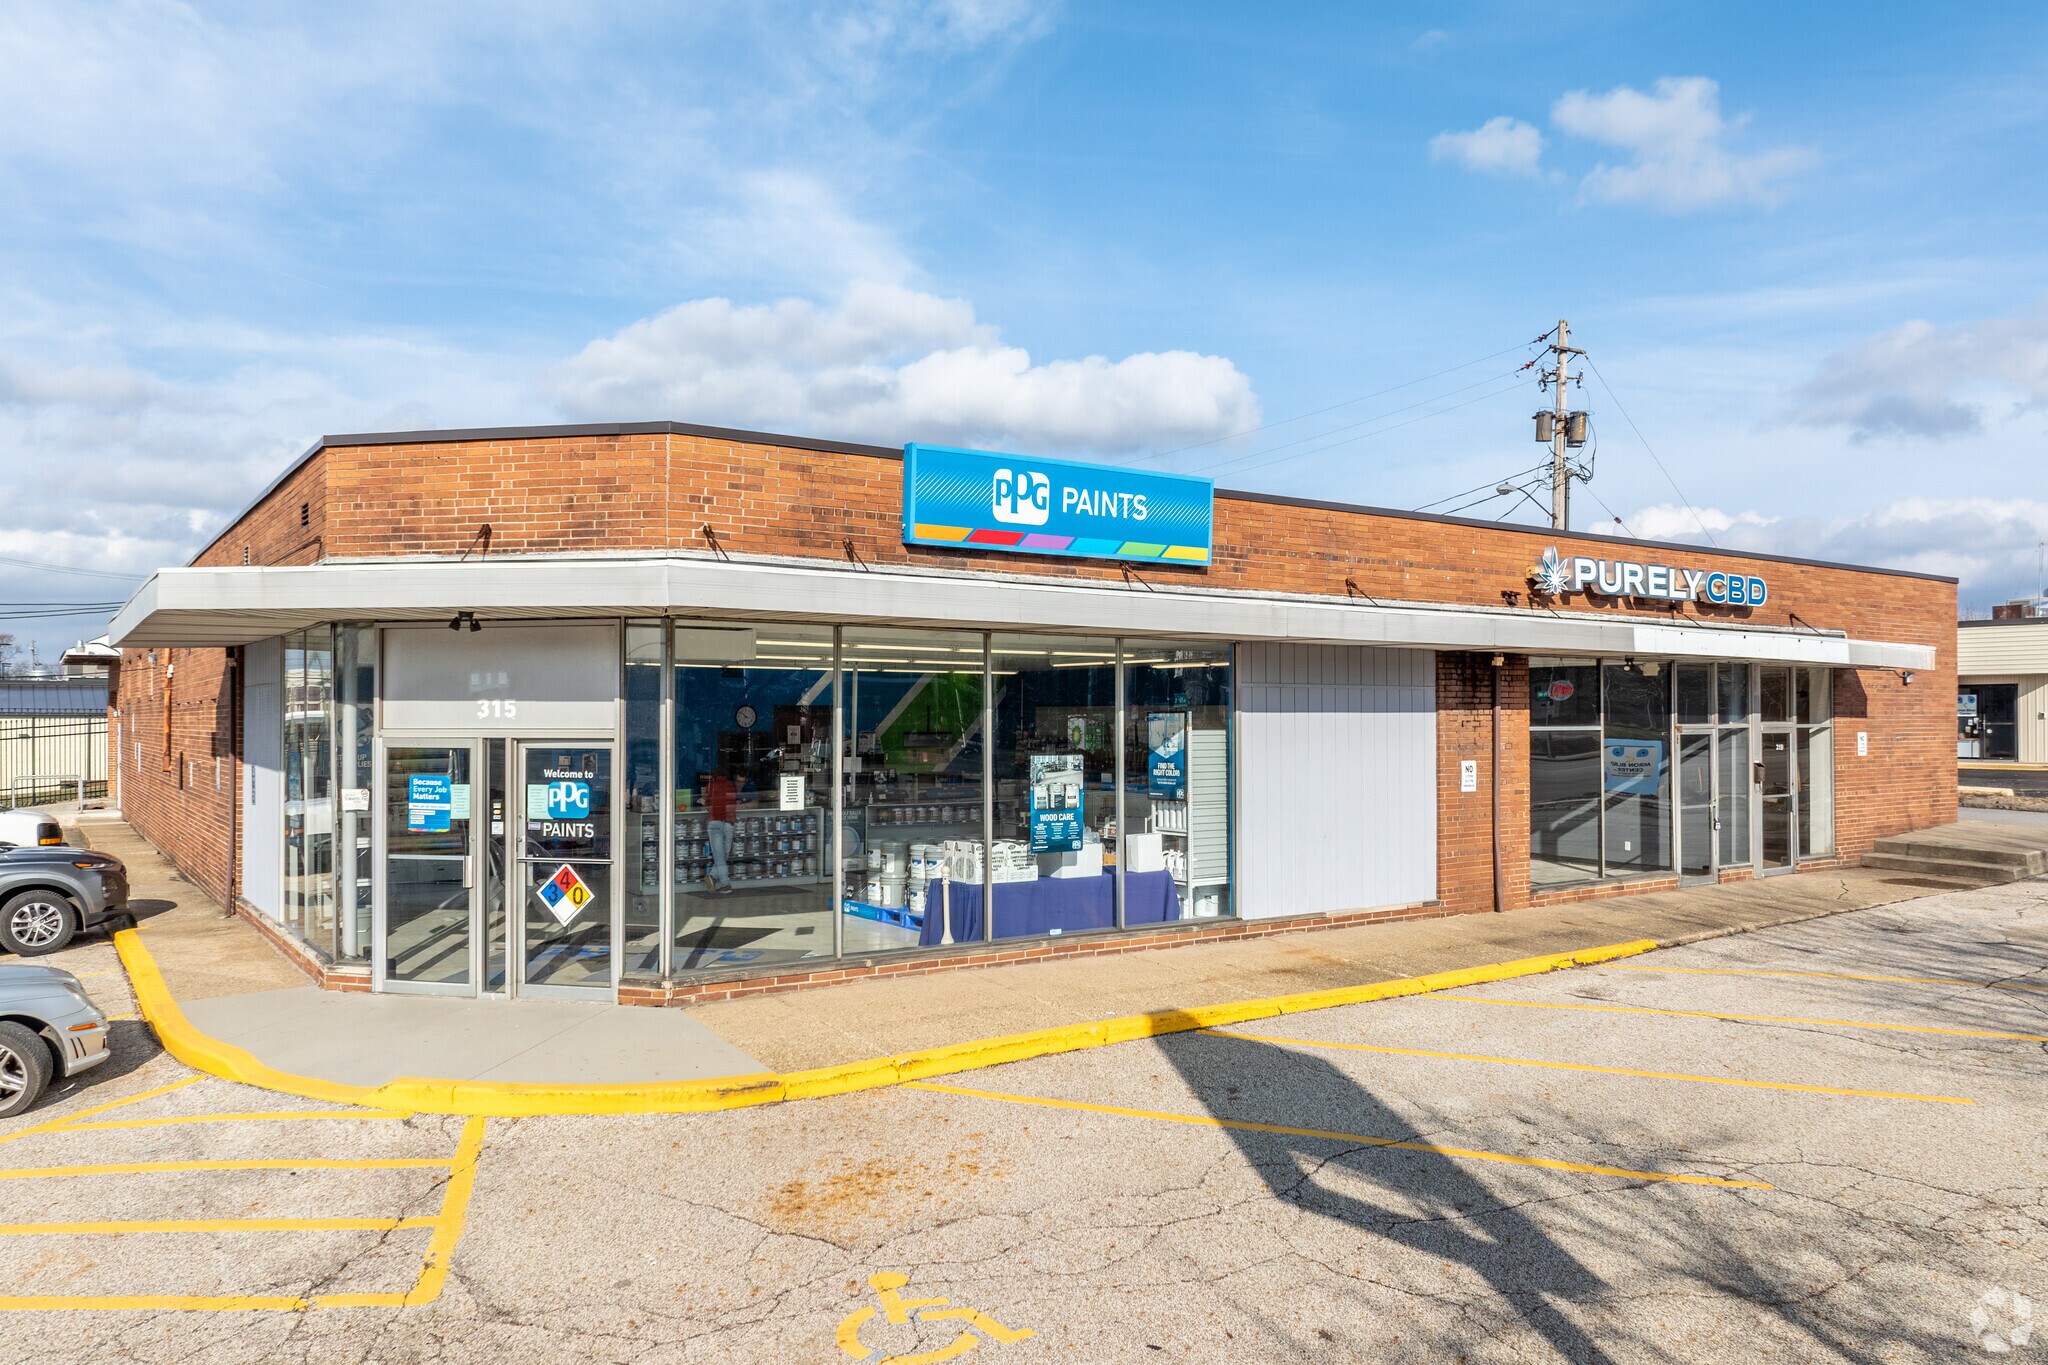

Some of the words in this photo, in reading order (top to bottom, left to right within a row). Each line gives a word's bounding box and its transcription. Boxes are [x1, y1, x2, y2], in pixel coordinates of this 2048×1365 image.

[995, 469, 1048, 514] PPG
[1062, 487, 1148, 521] PAINTS
[1574, 557, 1703, 601] PURELY
[1706, 571, 1767, 606] CBD
[477, 699, 516, 719] 315
[544, 769, 582, 778] Welcome
[584, 770, 593, 779] to
[1465, 765, 1473, 773] NO
[413, 778, 442, 786] Because
[413, 785, 433, 794] Every
[548, 782, 588, 812] PPG
[1040, 814, 1058, 822] WOOD
[1058, 813, 1074, 821] CARE
[543, 823, 594, 838] PAINTS
[560, 872, 570, 889] 4
[548, 884, 558, 902] 3
[573, 887, 583, 904] 0
